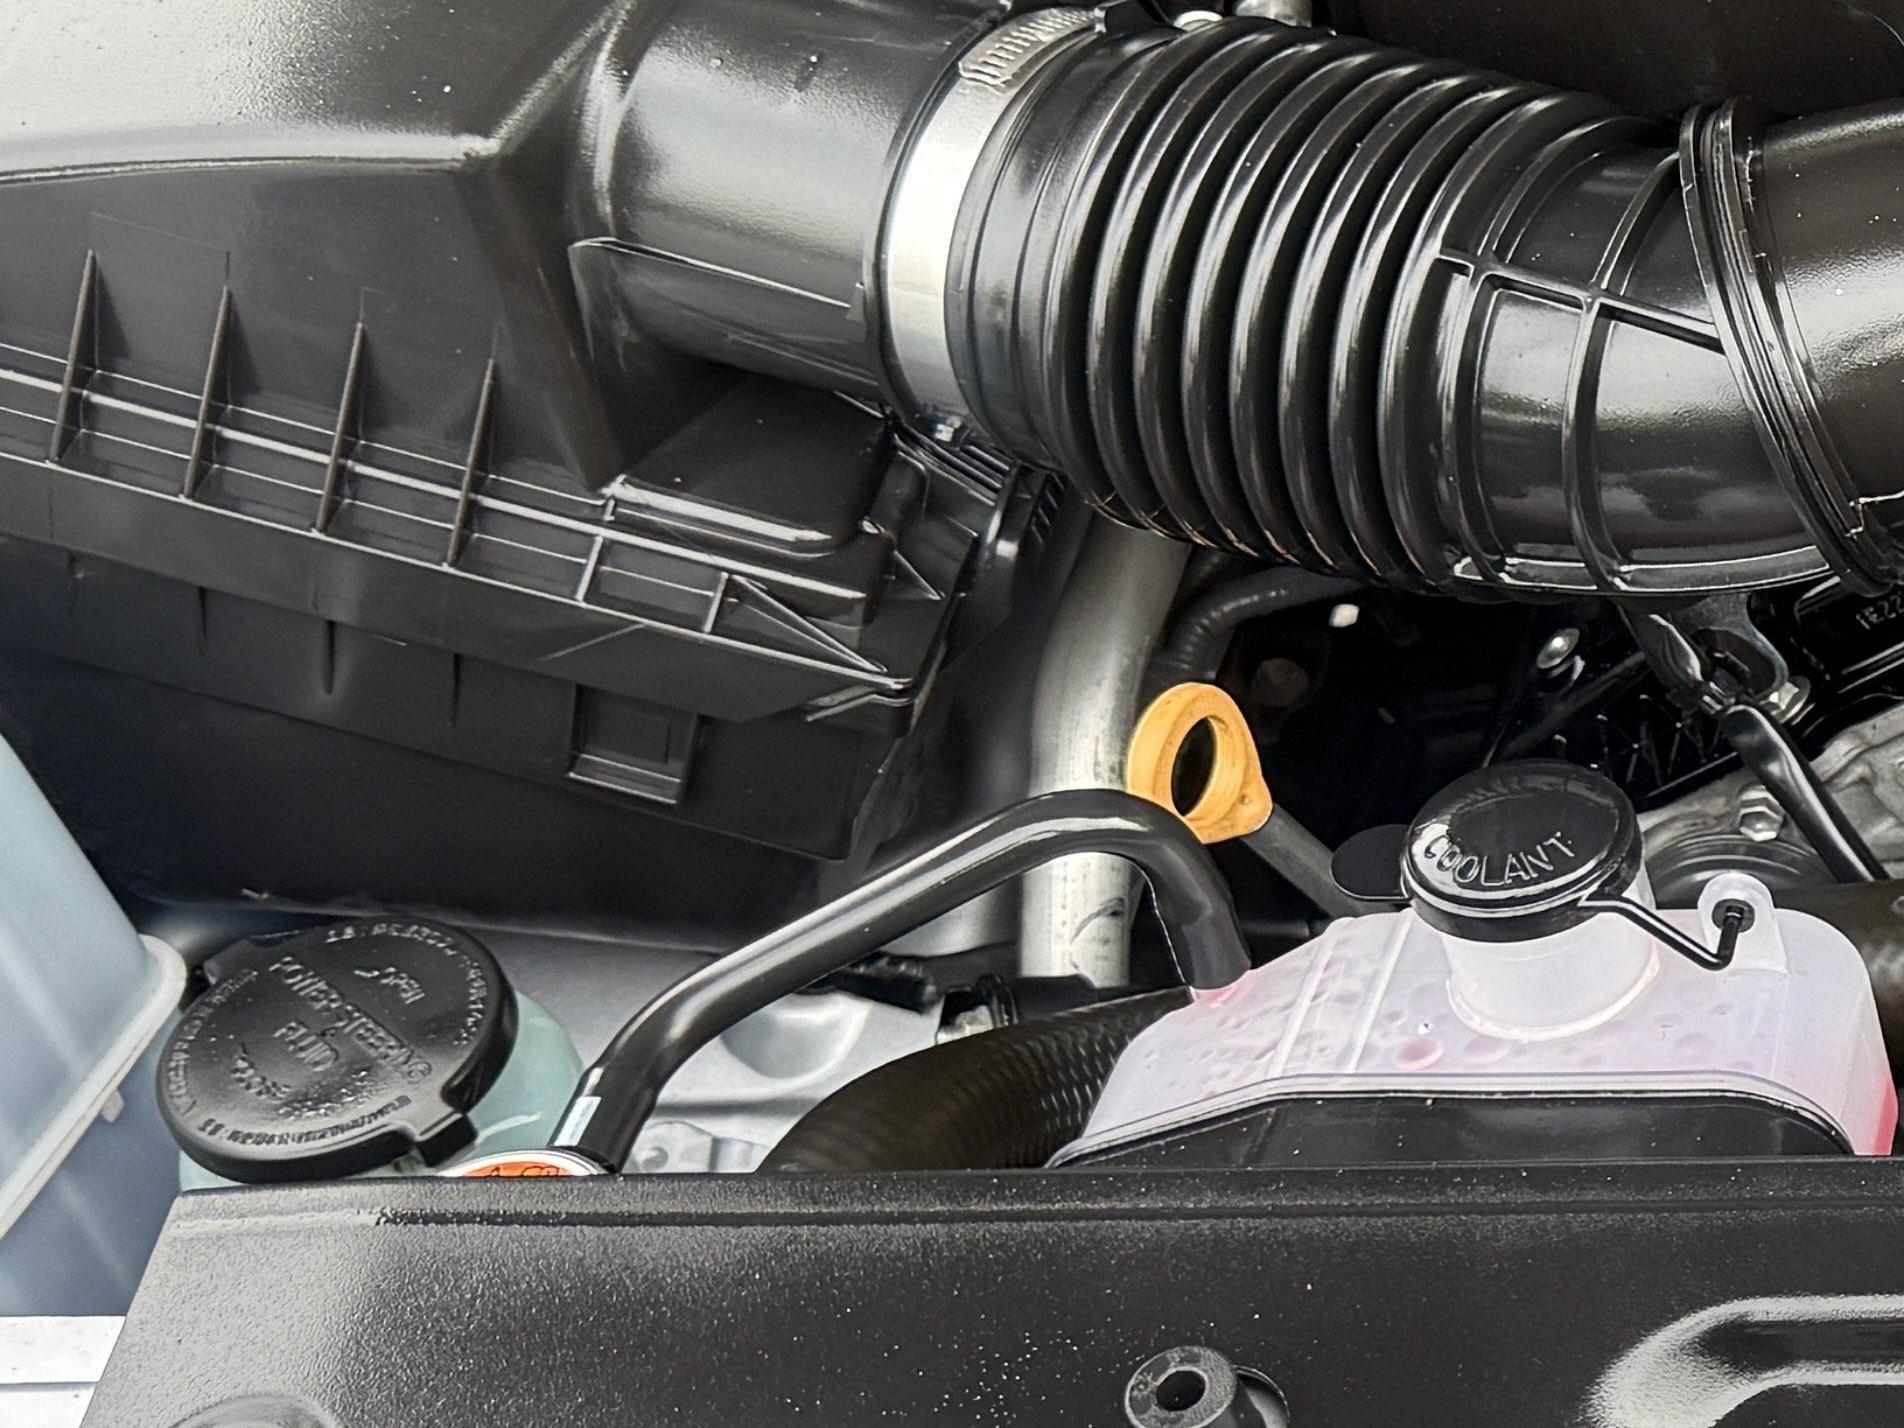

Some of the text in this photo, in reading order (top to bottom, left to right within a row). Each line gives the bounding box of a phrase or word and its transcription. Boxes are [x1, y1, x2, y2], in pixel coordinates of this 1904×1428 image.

[1422, 830, 1579, 889] COOLANT
[267, 954, 346, 1013] POWER
[332, 1003, 433, 1084] STEERING
[272, 1019, 341, 1074] FLUID
